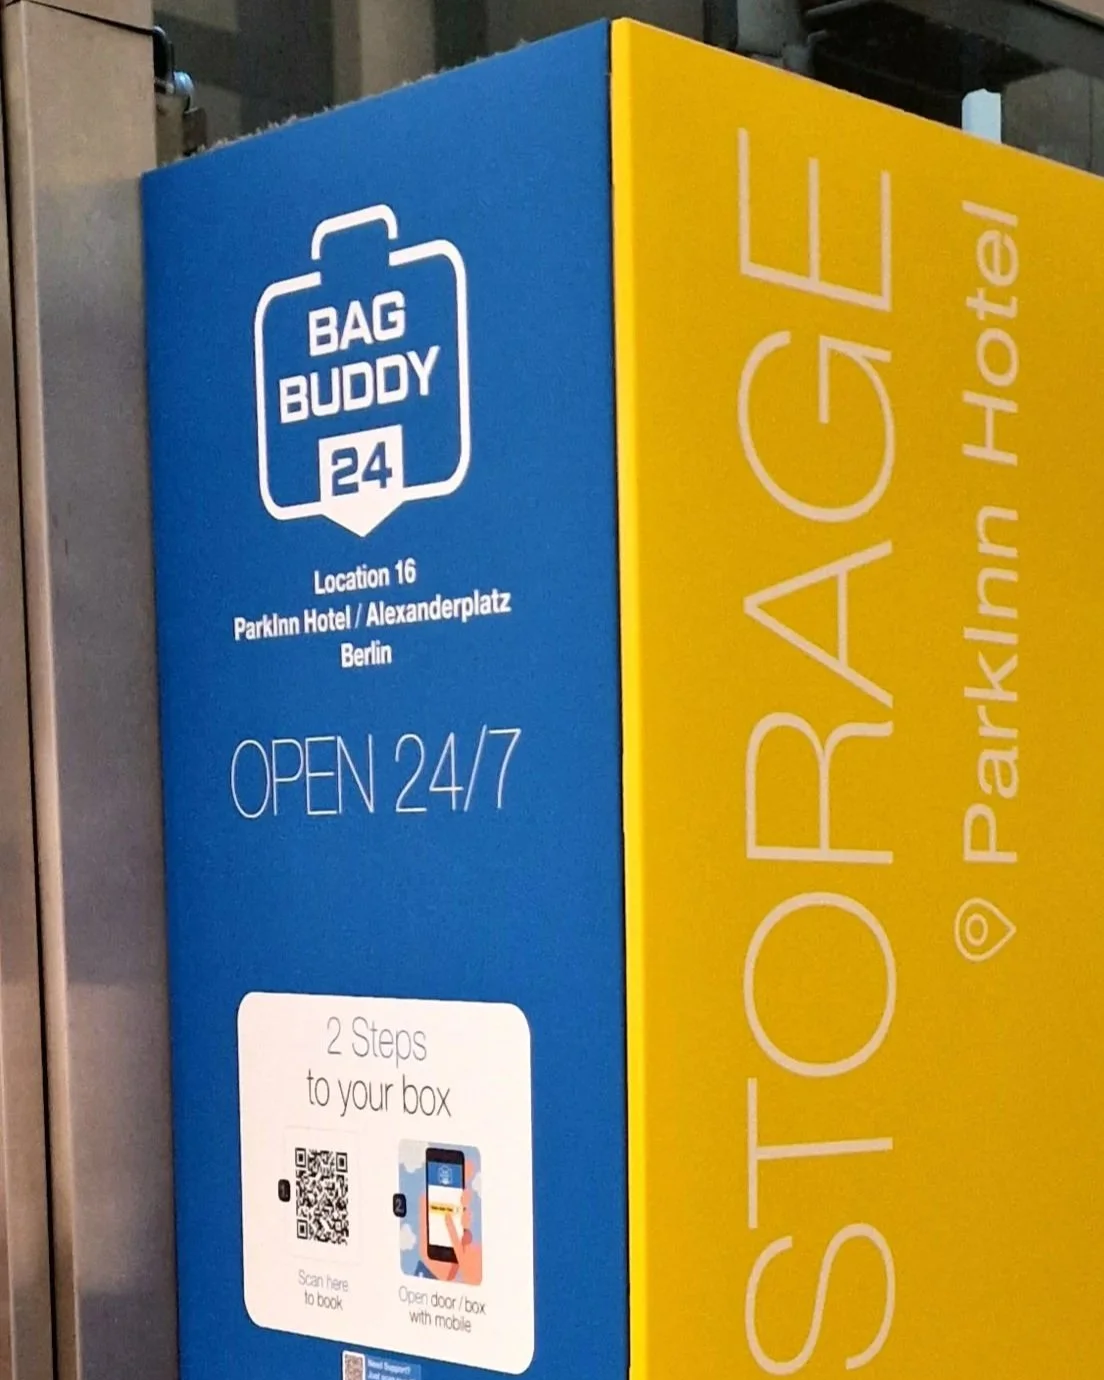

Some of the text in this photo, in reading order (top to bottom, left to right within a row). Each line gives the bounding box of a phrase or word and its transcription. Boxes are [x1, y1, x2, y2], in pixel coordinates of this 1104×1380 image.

[308, 290, 405, 357] BAG
[961, 199, 1019, 467] Hotel
[278, 346, 440, 424] BUDDY
[331, 441, 393, 496] 24
[314, 557, 416, 595] Location 16
[234, 613, 299, 641] ParkInn
[303, 605, 350, 633] Hotel
[366, 588, 511, 627] Alexanderplatz
[341, 640, 392, 668] Berlin
[230, 723, 522, 819] OPEN 24/7
[737, 126, 896, 1375] STORAGE
[326, 1016, 427, 1068] 2 Steps
[306, 1069, 452, 1117] to your box
[298, 1269, 349, 1292] Scan here
[304, 1289, 344, 1311] to book
[398, 1285, 428, 1305] Open
[430, 1291, 457, 1310] door
[464, 1296, 487, 1315] box
[409, 1309, 472, 1334] with mobile
